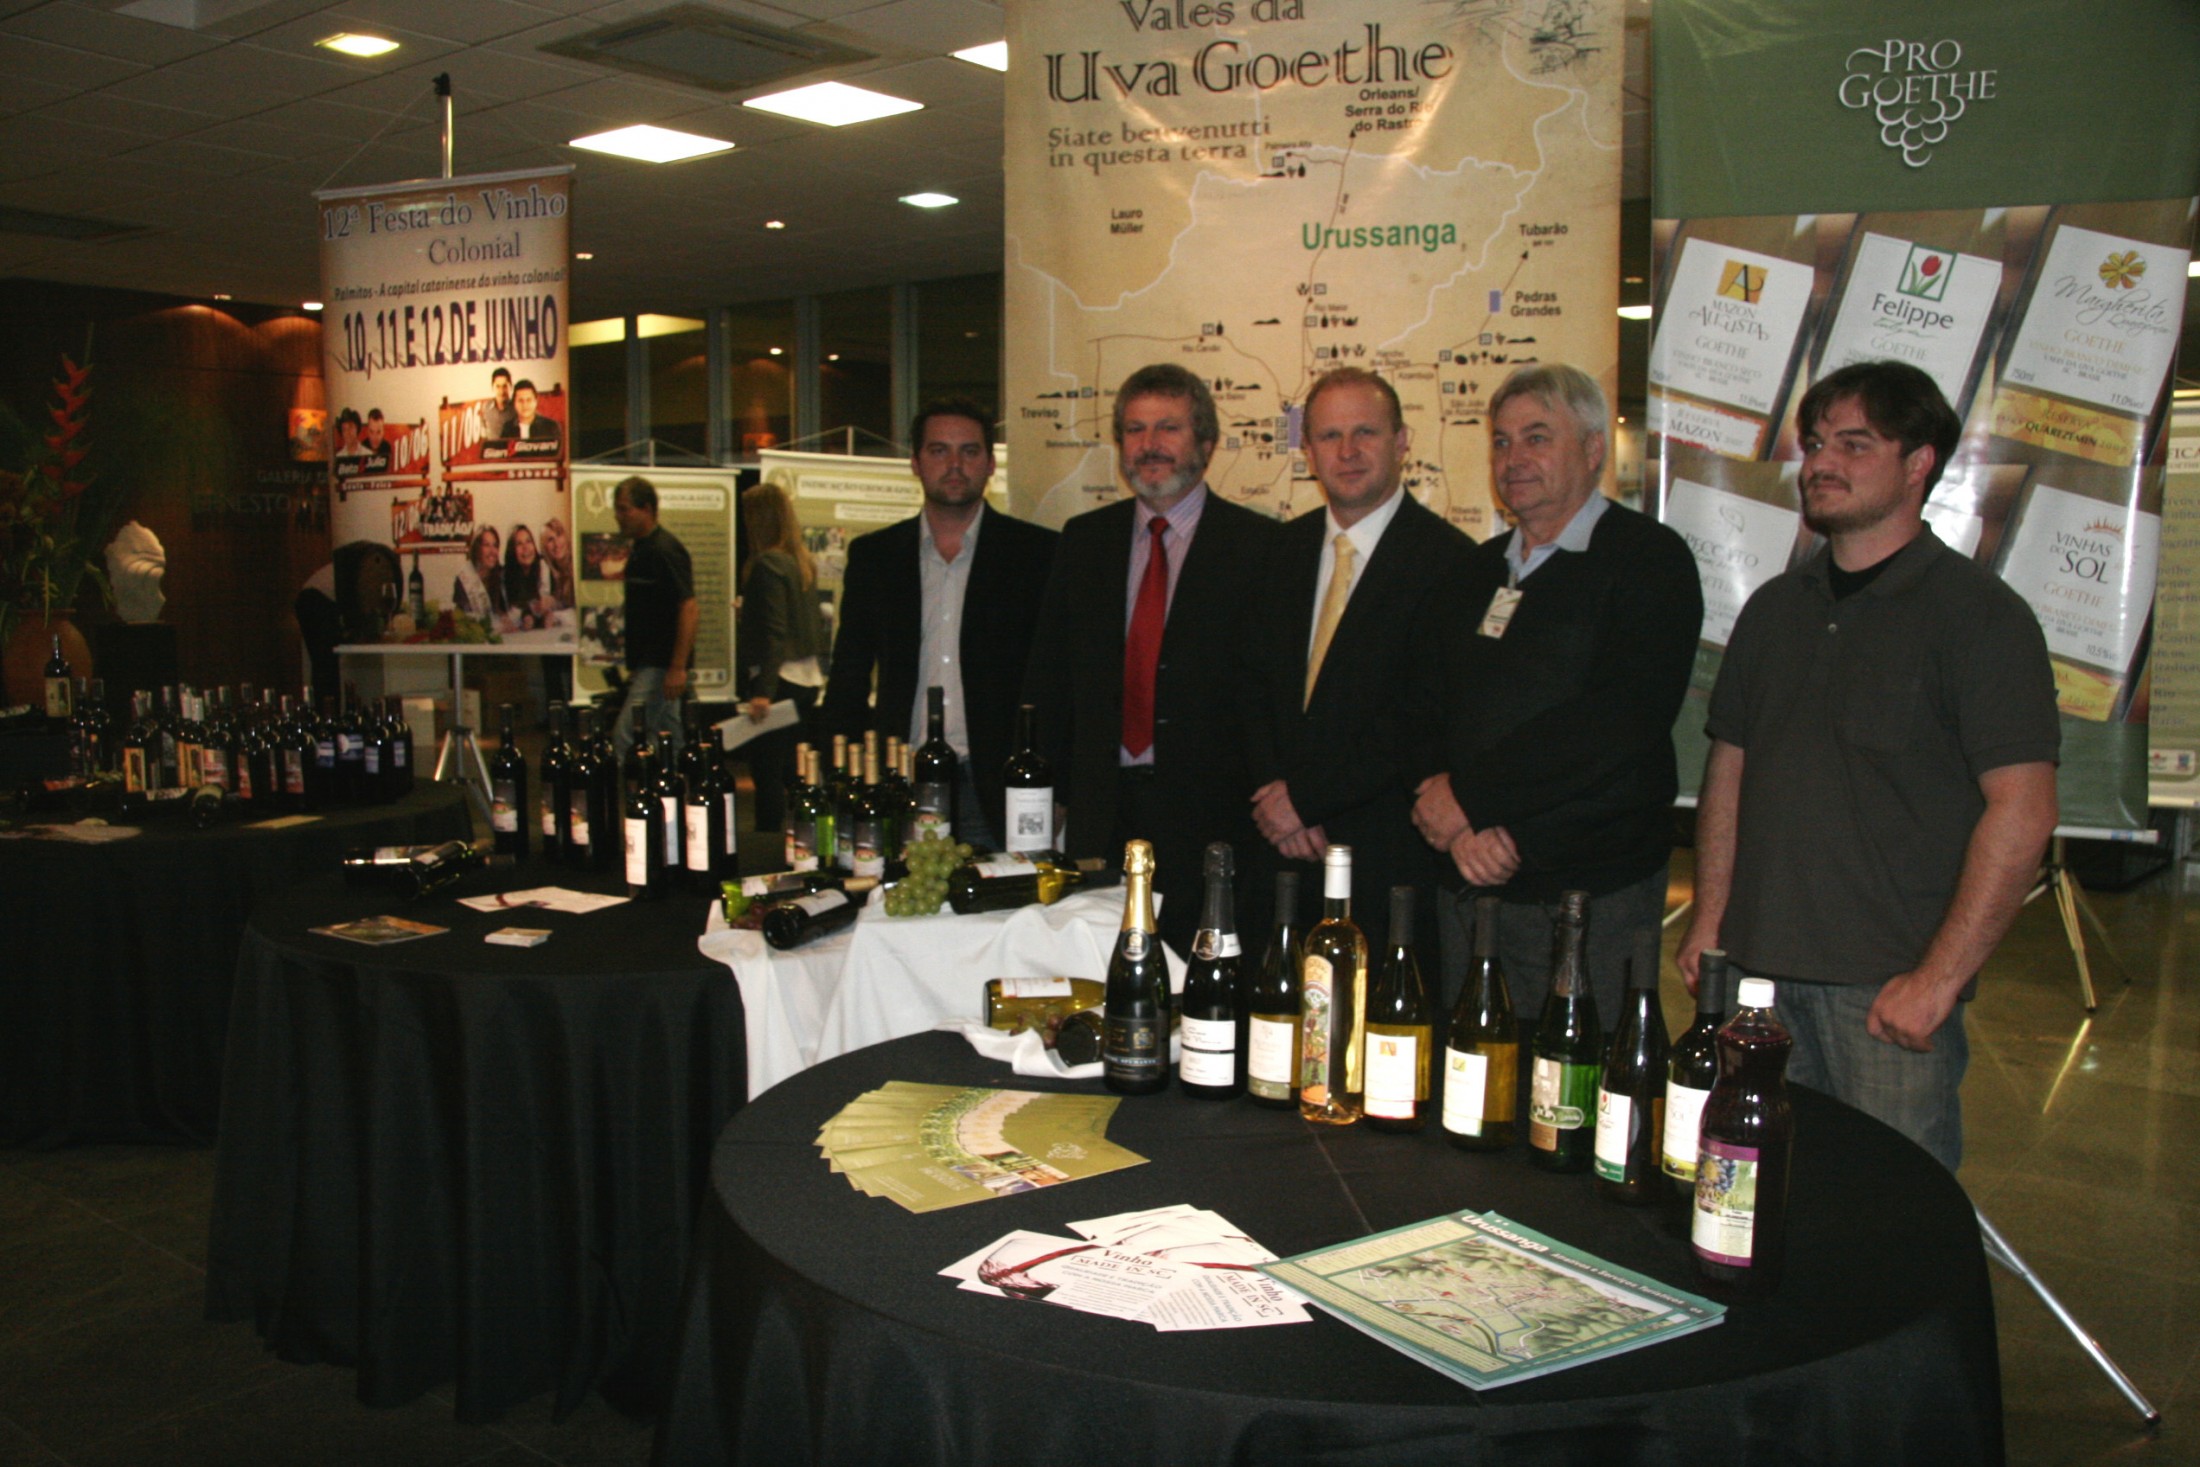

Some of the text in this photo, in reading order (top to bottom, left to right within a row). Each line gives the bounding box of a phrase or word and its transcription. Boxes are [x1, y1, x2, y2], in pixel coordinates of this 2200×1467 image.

[1123, 0, 1305, 32] Vales da
[1044, 23, 1455, 103] Uva Goethe
[1850, 39, 1962, 72] PRO
[1359, 86, 1420, 102] Orleans/
[1839, 70, 1998, 109] GOETHE
[1345, 105, 1383, 118] Serra
[1387, 103, 1407, 116] do
[1048, 127, 1112, 149] Siate
[1355, 120, 1374, 133] do
[1048, 141, 1247, 176] in questa terra
[368, 202, 431, 234] Festa
[440, 194, 472, 226] do
[480, 184, 567, 222] Vinho
[1111, 207, 1144, 221] Lauro
[1110, 221, 1144, 234] Müller
[1301, 222, 1457, 252] Urussanga
[1519, 222, 1568, 237] Tubarão
[428, 232, 522, 265] Colonial
[387, 280, 420, 298] capital
[421, 276, 476, 293] catarinense
[492, 272, 519, 286] vinho
[1515, 290, 1558, 303] Pedras
[1511, 304, 1561, 318] Grandes
[1712, 299, 1758, 319] MAZON
[1872, 293, 1954, 329] Felippe
[421, 304, 445, 366] 12
[450, 301, 477, 365] DE
[483, 294, 558, 363] JUNHO
[2064, 329, 2128, 354] GOETHE
[1695, 335, 1749, 361] GOETHE
[1870, 336, 1927, 361] GOETHE
[1021, 407, 1059, 419] Treviso
[442, 400, 482, 462] 11/06
[1669, 418, 1721, 442] MAZON
[394, 423, 429, 473] 10/06
[2049, 545, 2066, 556] DO
[2056, 531, 2112, 557] VINHAS
[2059, 550, 2109, 585] SOL
[2043, 581, 2105, 609] GOETHE
[1461, 1214, 1550, 1253] Urussanga
[1077, 1258, 1166, 1276] MADE IN SC
[1104, 1249, 1154, 1266] Vinho
[1226, 1274, 1251, 1294] MADE
